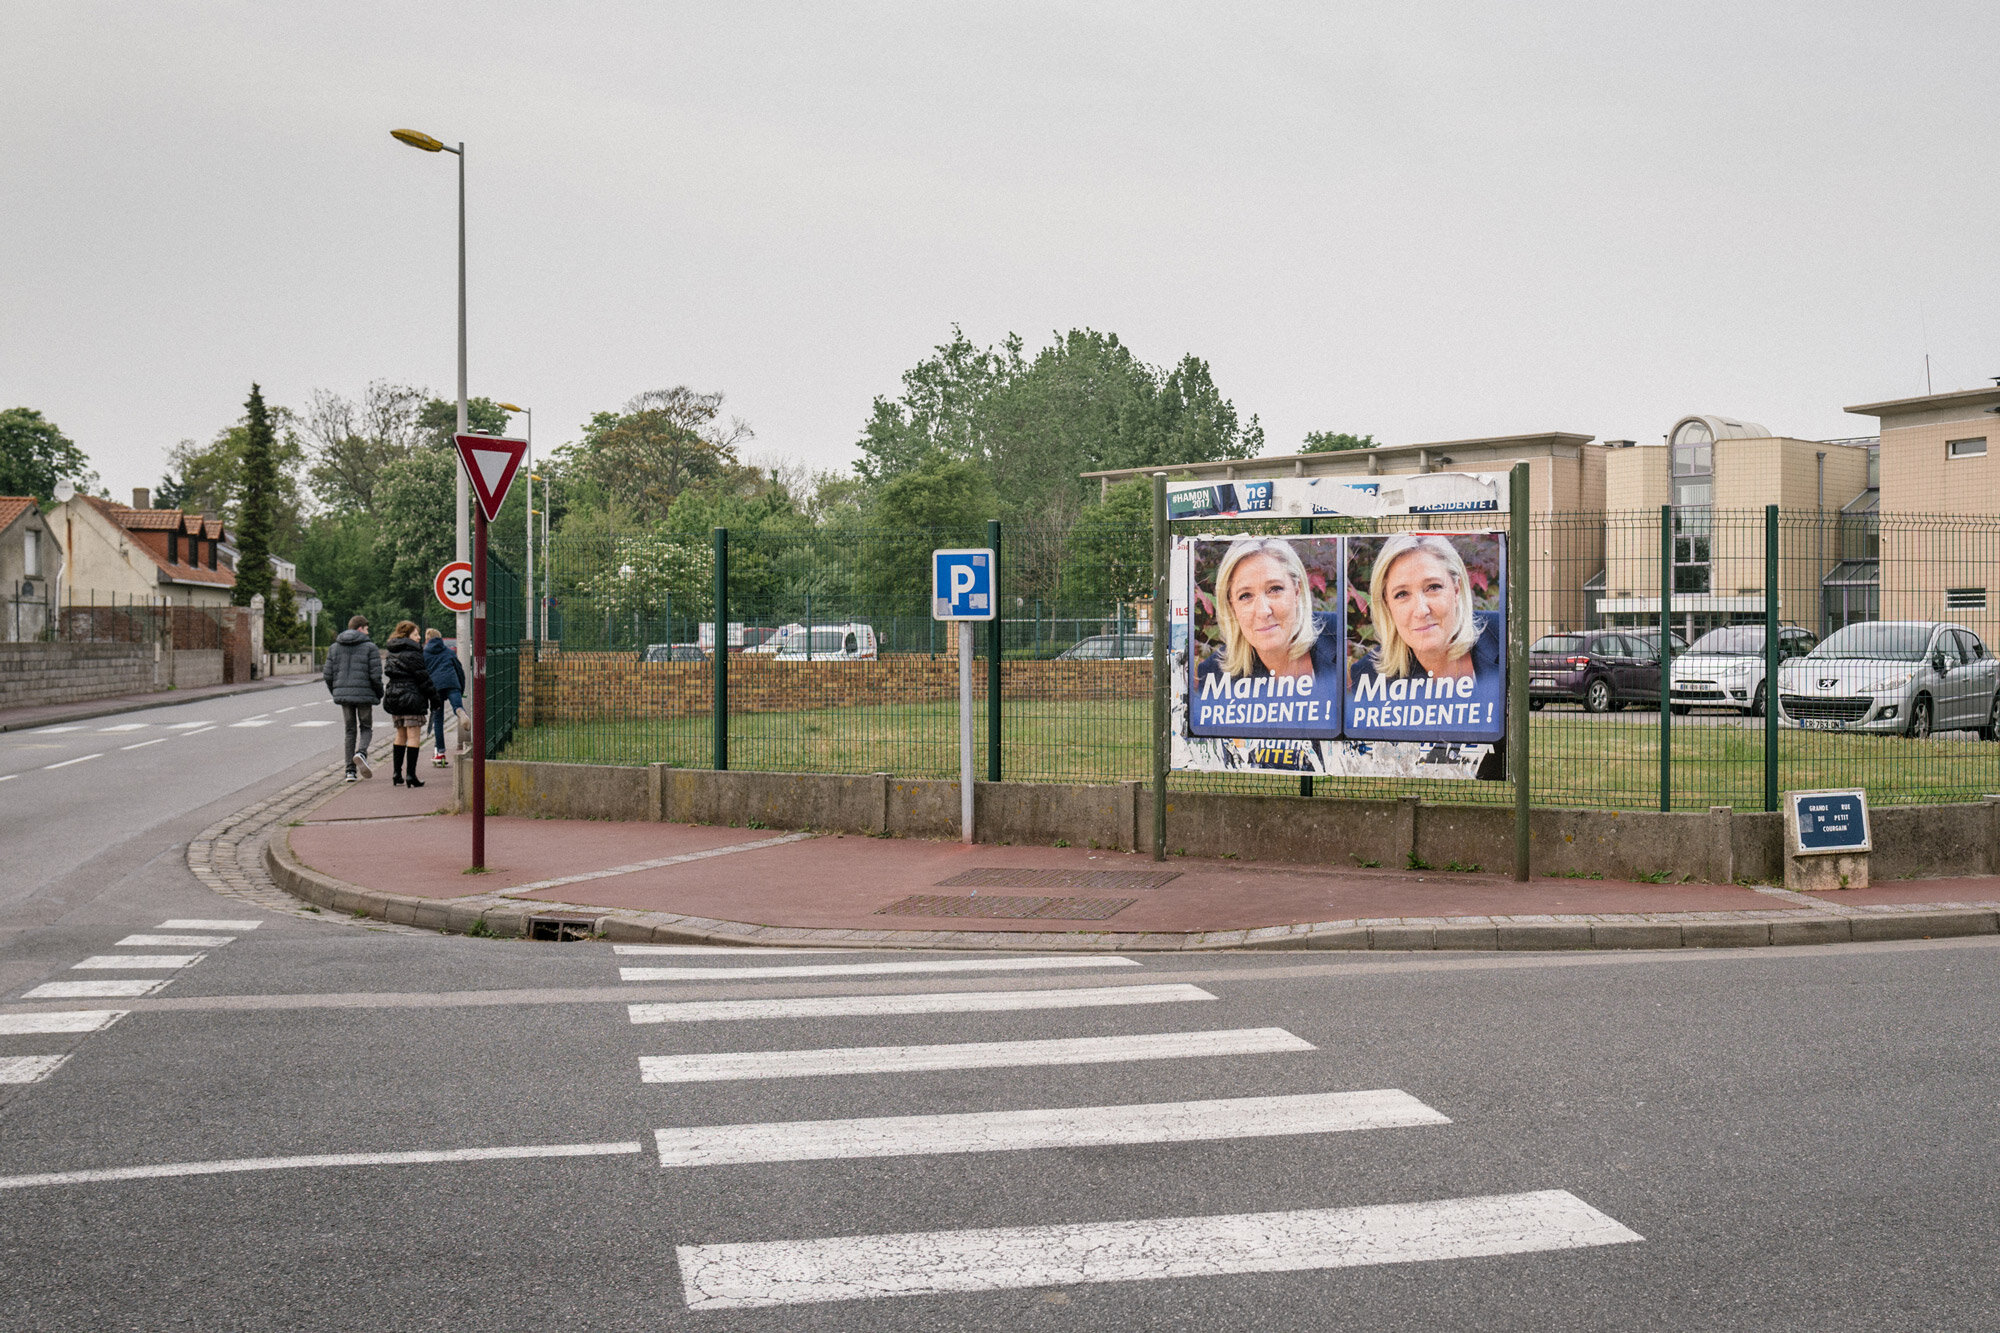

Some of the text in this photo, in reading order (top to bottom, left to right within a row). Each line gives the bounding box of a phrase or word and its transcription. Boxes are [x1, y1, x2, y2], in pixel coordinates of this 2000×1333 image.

[1172, 489, 1209, 503] #HAMON
[1192, 498, 1210, 509] 2017
[447, 577, 472, 596] 30
[951, 565, 975, 605] P
[1200, 669, 1313, 700] Marine
[1354, 670, 1473, 702] Marine
[1200, 699, 1331, 725] PRÉSIDENTE !
[1353, 701, 1493, 727] PRÉSIDENTE !
[1255, 748, 1293, 764] VITE
